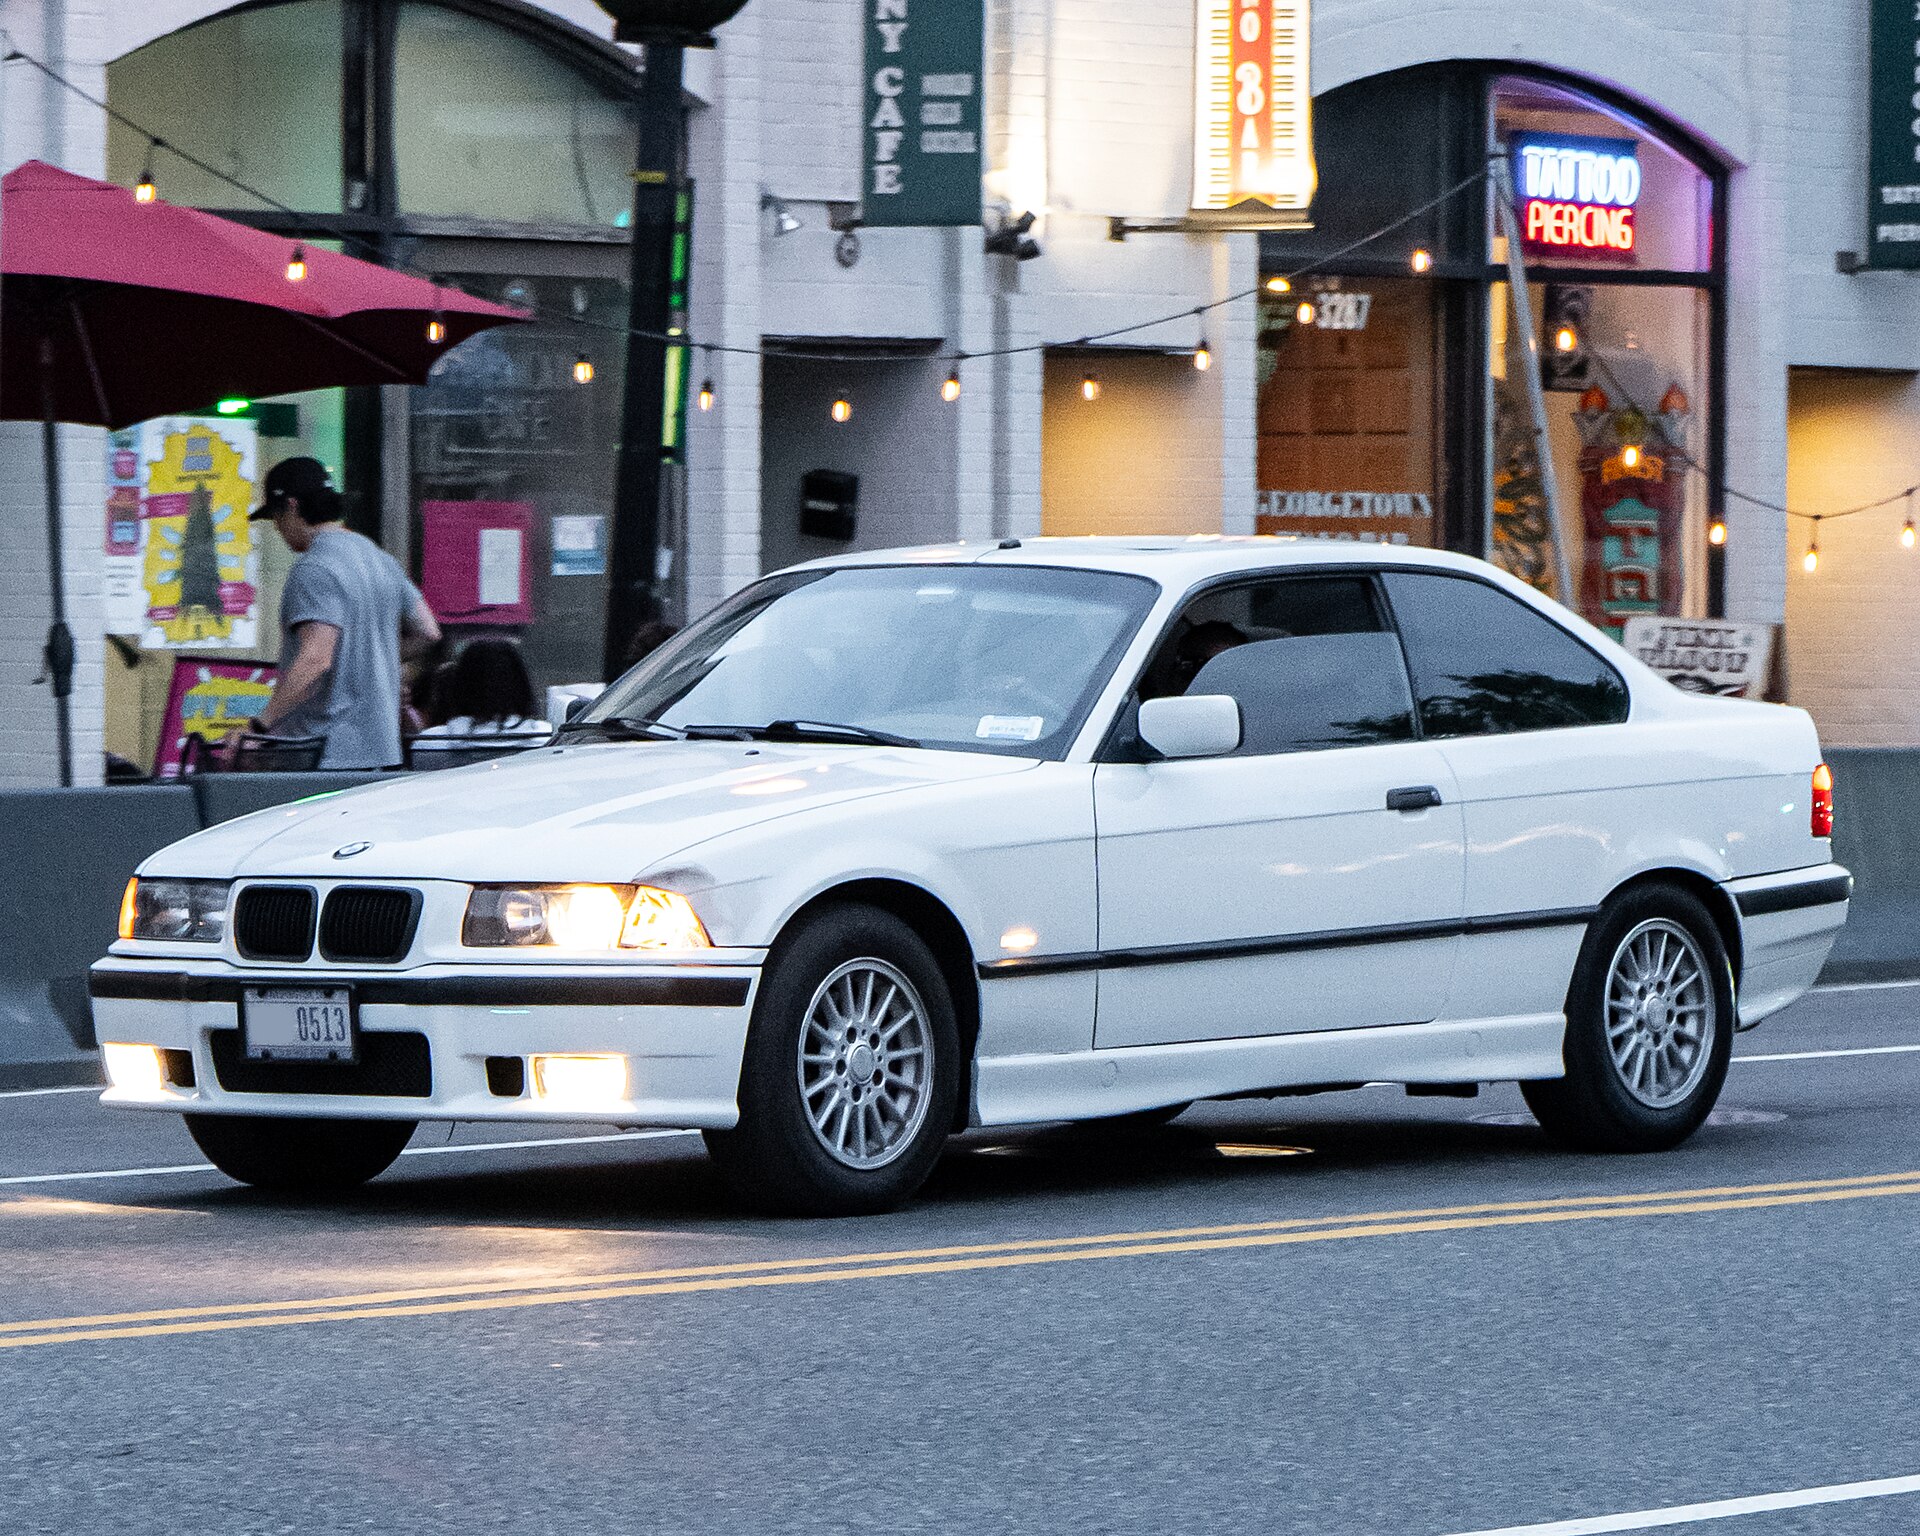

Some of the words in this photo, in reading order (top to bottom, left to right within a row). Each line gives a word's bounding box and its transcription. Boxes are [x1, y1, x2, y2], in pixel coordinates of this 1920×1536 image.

[870, 66, 905, 195] CAFE
[1522, 145, 1641, 206] TATTOO
[1527, 200, 1634, 250] PIERCING
[296, 1006, 346, 1041] 0513
